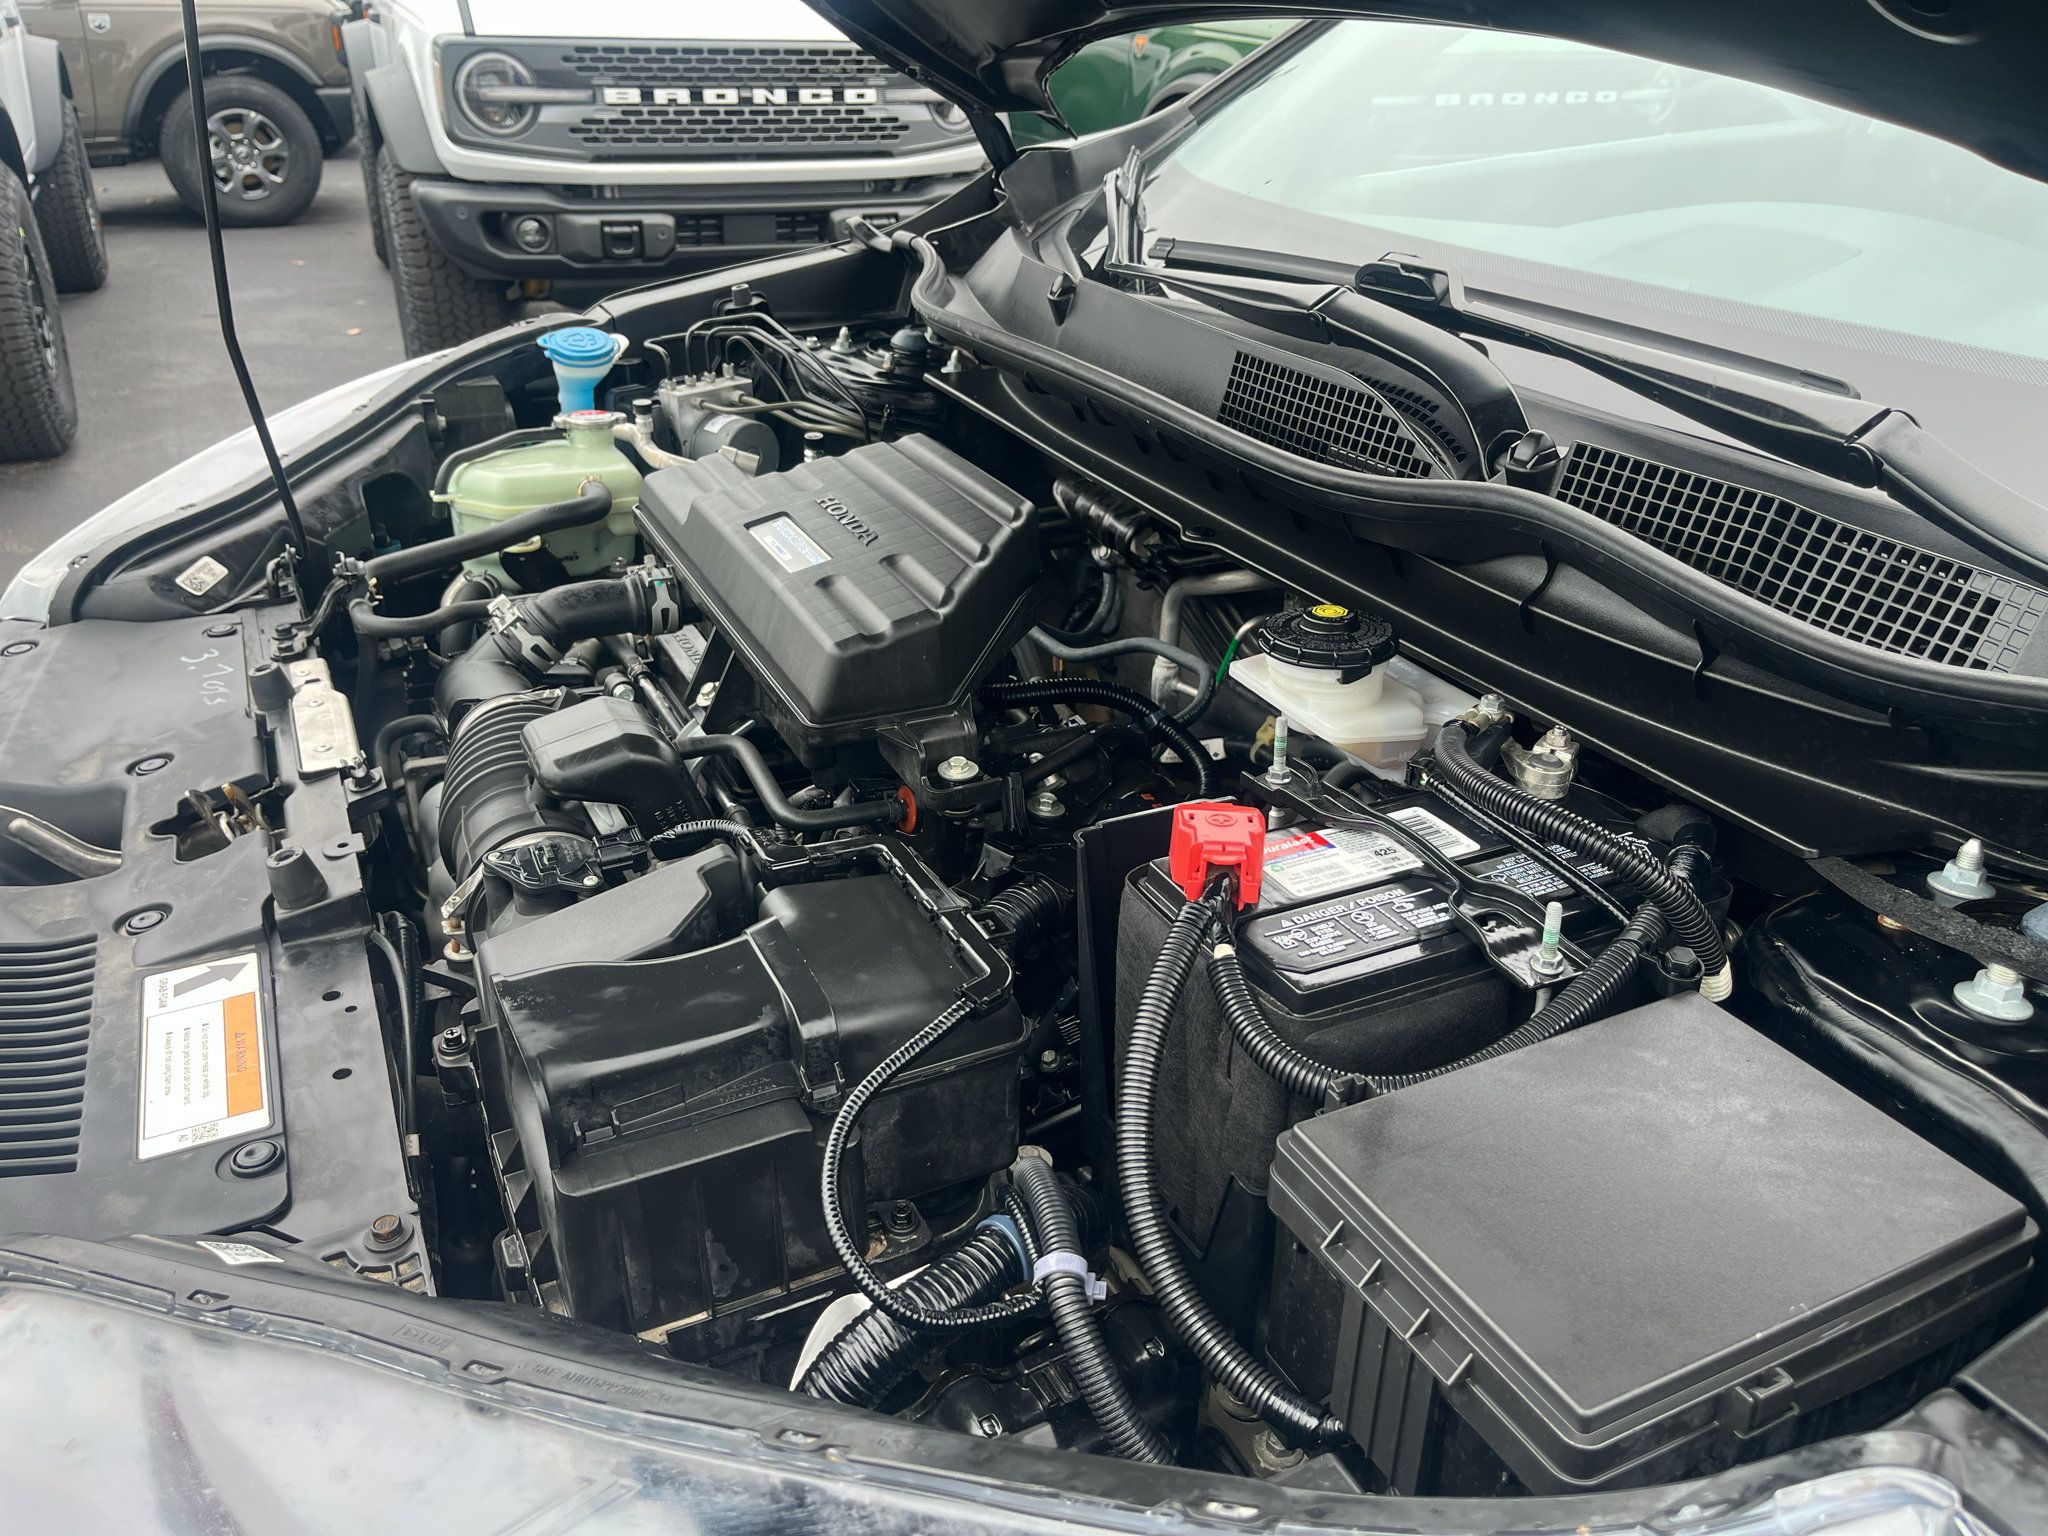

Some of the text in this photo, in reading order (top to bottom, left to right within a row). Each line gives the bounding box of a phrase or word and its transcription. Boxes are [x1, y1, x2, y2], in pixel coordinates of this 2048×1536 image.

[604, 86, 877, 106] BRONCO
[1435, 90, 1618, 106] BRONCO
[815, 495, 879, 547] HONDA
[672, 633, 702, 665] HOND
[1374, 846, 1398, 858] 425
[1292, 888, 1406, 924] DANGER / POISON
[235, 1038, 247, 1073] WARNING
